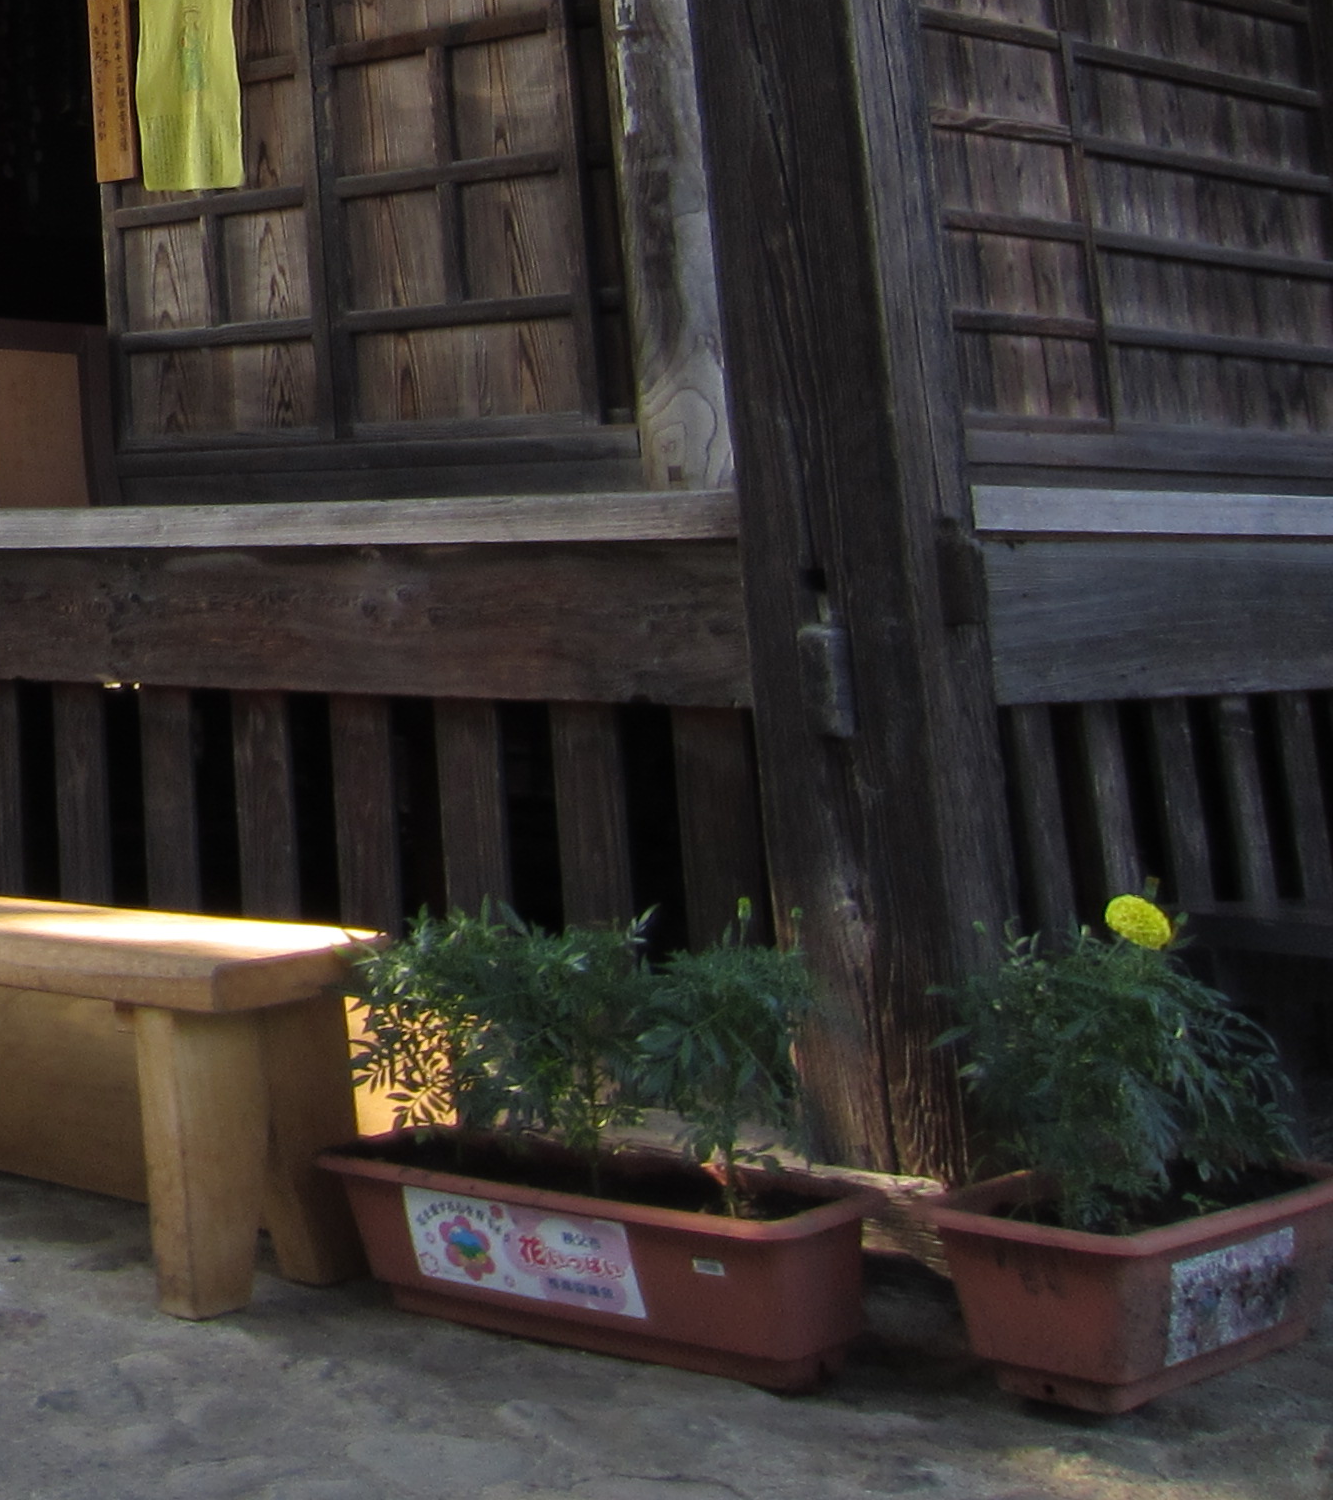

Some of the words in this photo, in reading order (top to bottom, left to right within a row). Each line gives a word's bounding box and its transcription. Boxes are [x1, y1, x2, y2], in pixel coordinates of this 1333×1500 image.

[517, 1234, 627, 1281] 花いっぱい
